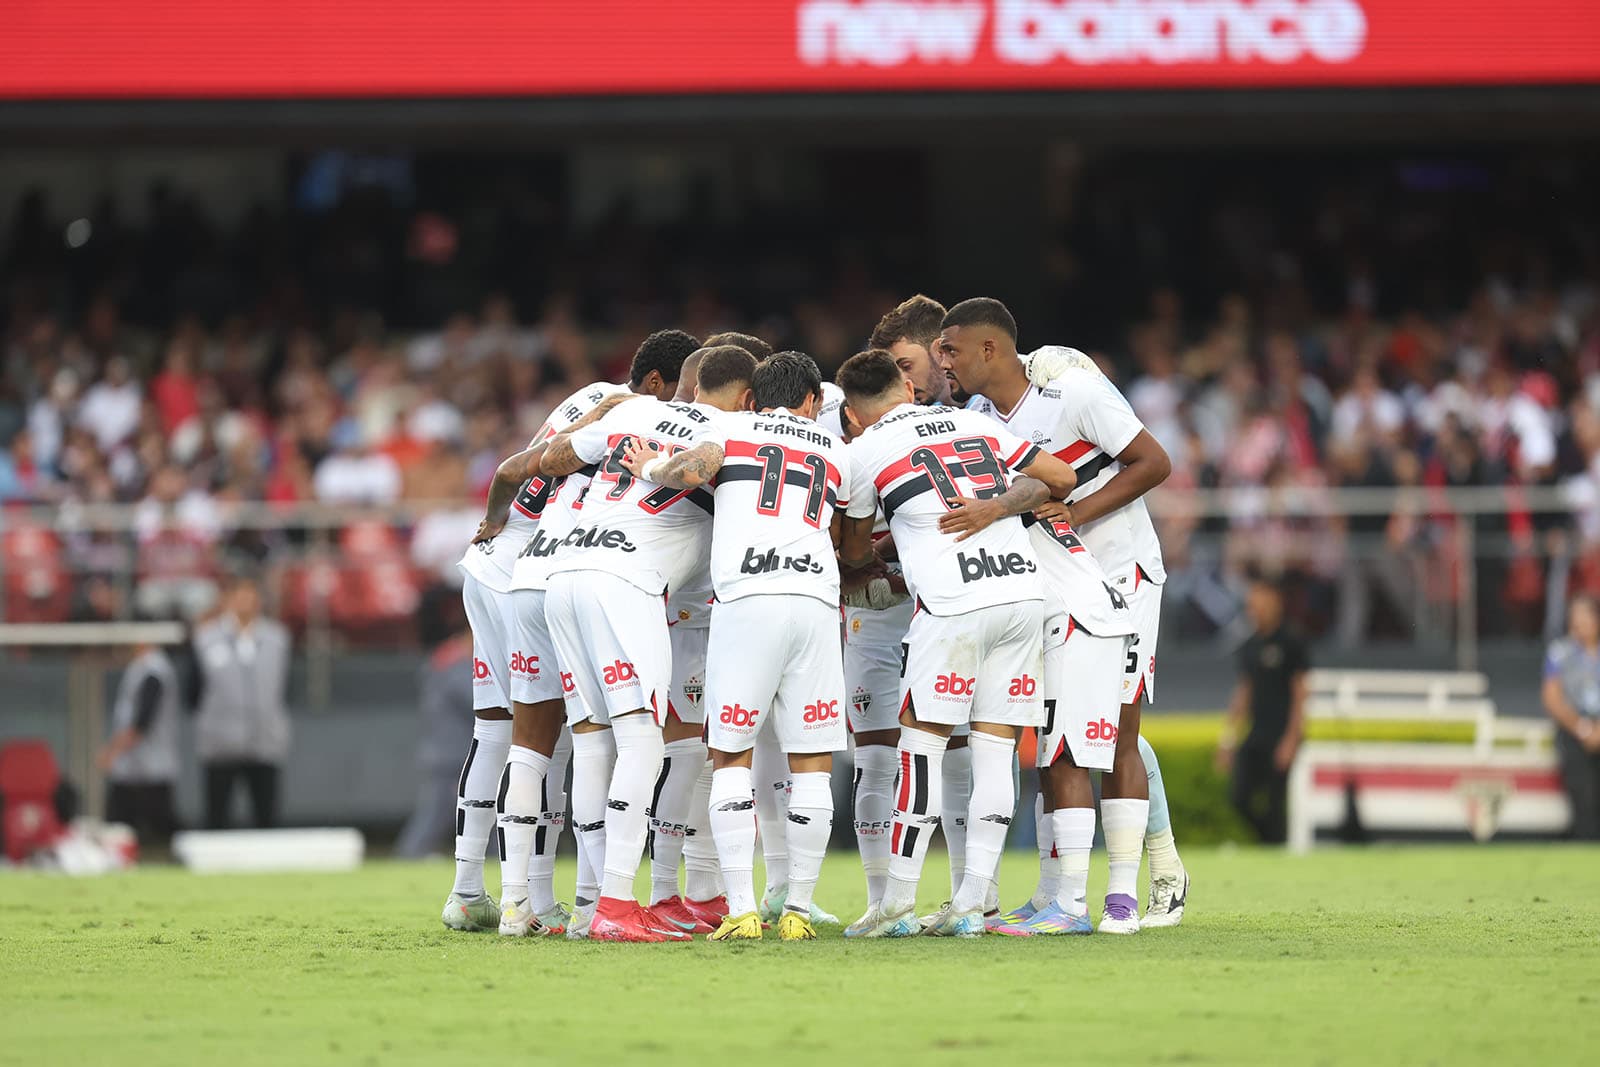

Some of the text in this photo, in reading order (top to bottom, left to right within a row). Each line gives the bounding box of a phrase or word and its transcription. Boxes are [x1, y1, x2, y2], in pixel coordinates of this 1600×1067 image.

[797, 0, 1369, 66] new balance
[753, 422, 832, 449] FERREIRA
[757, 443, 829, 529] 11
[910, 435, 1009, 513] 13
[957, 547, 1029, 583] blue
[511, 651, 540, 674] abc
[935, 672, 976, 696] abc
[1008, 674, 1036, 696] ab
[719, 703, 759, 727] abc
[803, 699, 839, 723] abc
